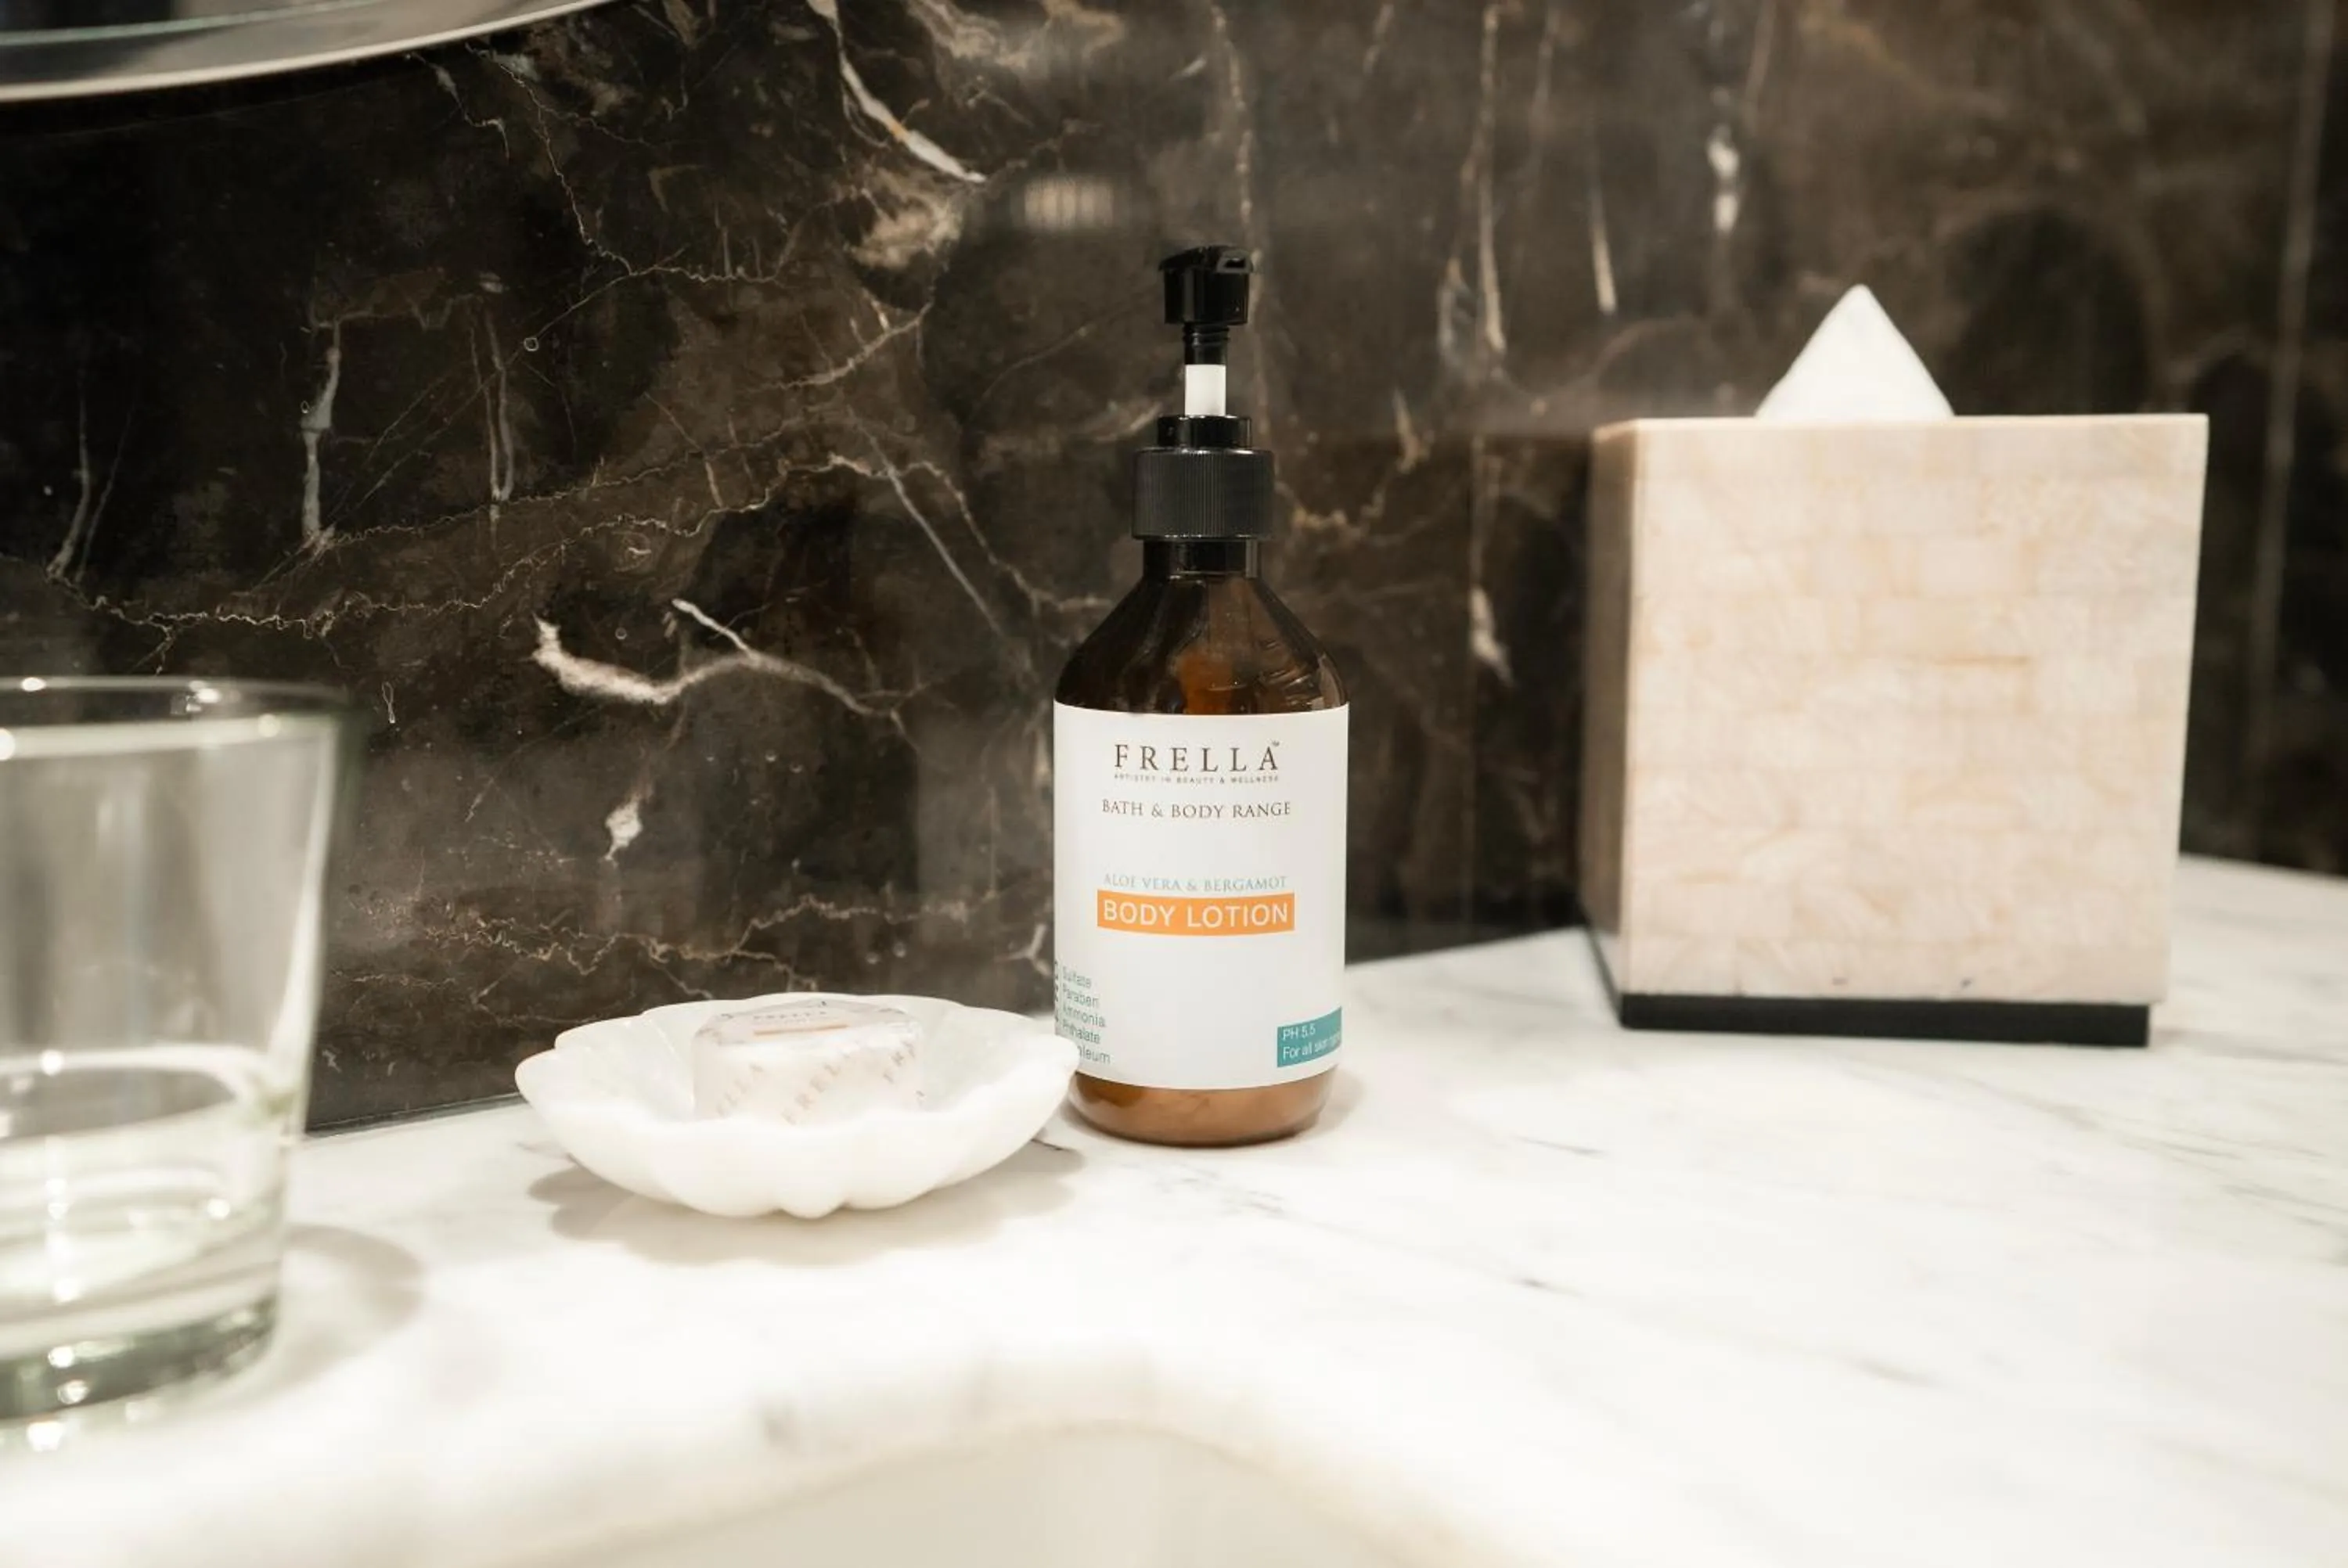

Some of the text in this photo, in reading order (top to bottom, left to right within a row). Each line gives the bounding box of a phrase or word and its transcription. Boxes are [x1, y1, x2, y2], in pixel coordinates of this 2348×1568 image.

[1115, 744, 1278, 772] FRELLA
[1102, 799, 1291, 819] BATH & BODY RANGE
[1104, 874, 1287, 893] ALOE VERA & BERGAMOT
[1104, 899, 1288, 928] BODY LOTION
[1302, 1023, 1316, 1038] 5.5
[1283, 1046, 1300, 1059] For
